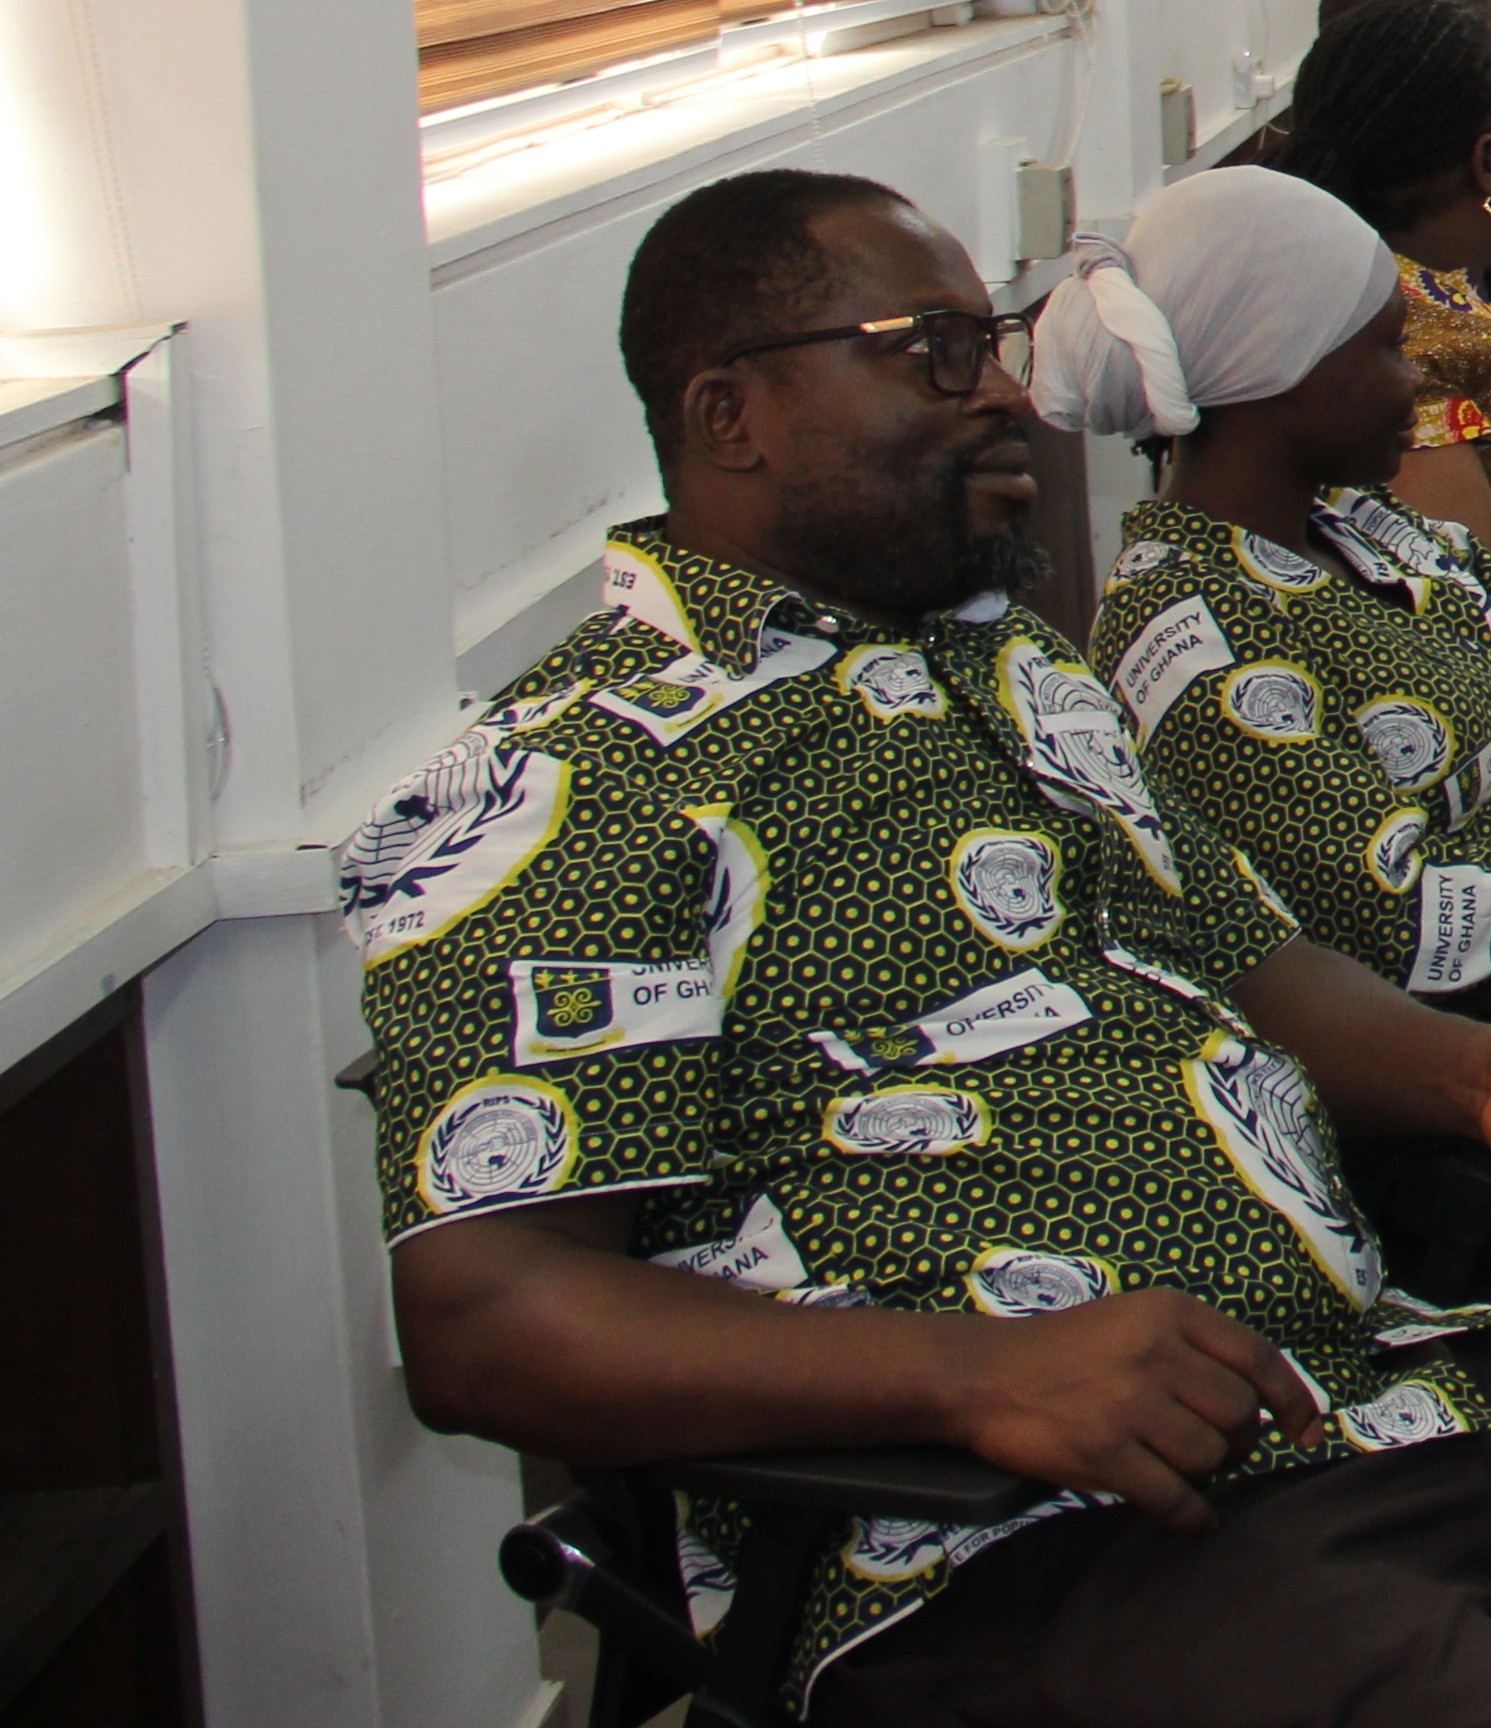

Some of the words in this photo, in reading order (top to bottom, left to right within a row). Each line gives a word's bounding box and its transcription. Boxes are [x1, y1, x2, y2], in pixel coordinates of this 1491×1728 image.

[1126, 612, 1201, 688] UNIVERSITY
[1136, 681, 1149, 704] OF
[1151, 634, 1203, 682] GHANA
[388, 911, 425, 934] 1972
[1427, 874, 1453, 981] UNIVERSITY
[1448, 959, 1463, 982] OF
[1458, 885, 1477, 952] GHANA
[634, 983, 667, 1006] OF
[716, 1246, 769, 1281] ANA
